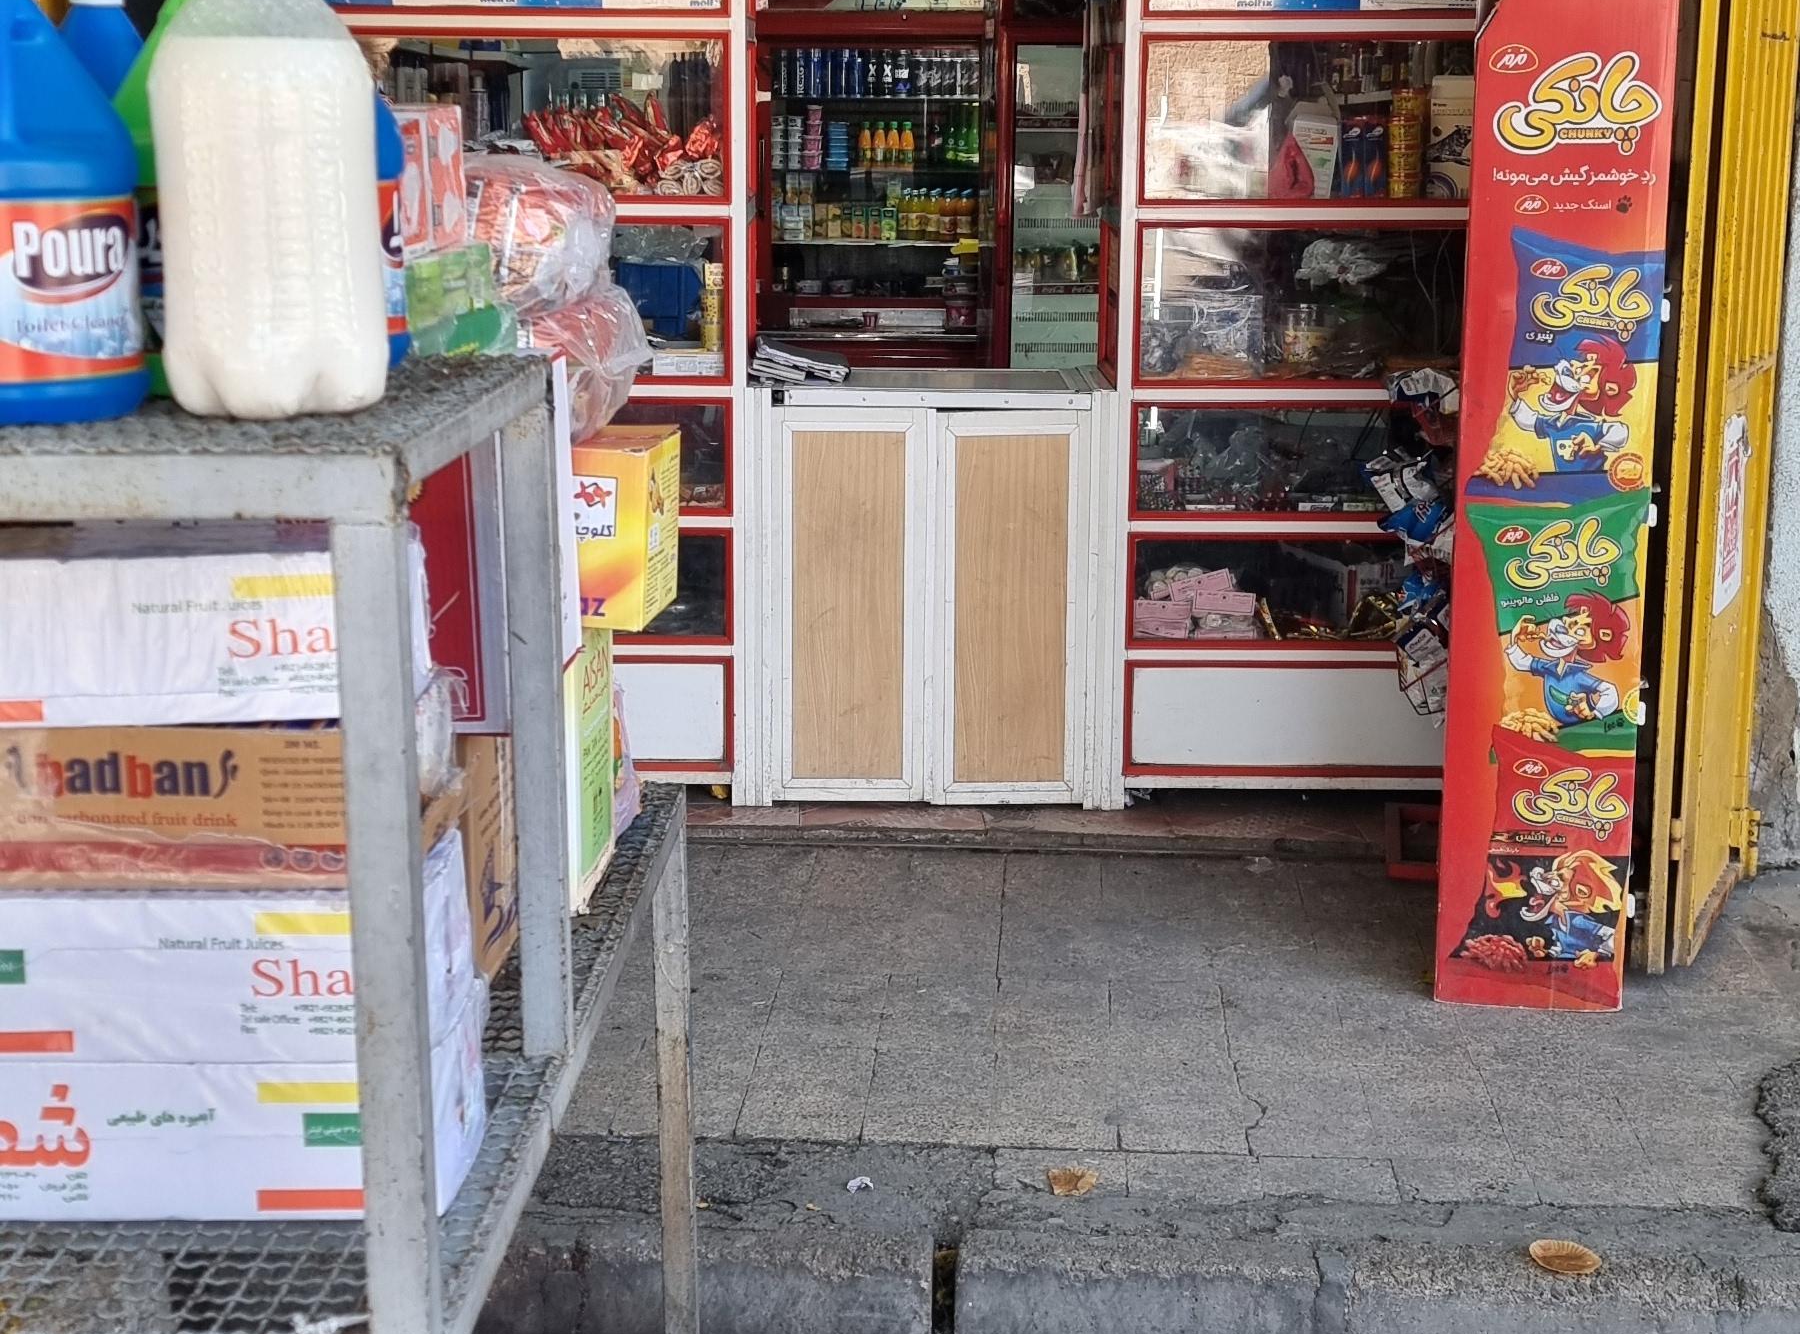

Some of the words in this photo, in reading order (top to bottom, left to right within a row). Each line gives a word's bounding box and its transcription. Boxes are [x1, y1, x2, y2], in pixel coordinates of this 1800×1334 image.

[1496, 48, 1528, 69] مزمز
[1497, 54, 1659, 153] چانکی
[1558, 127, 1614, 140] CHUNKY
[1553, 200, 1579, 211] جدید
[1581, 199, 1611, 210] اسنک
[12, 220, 127, 280] Poura
[1532, 265, 1652, 341] چانکی
[1576, 314, 1616, 328] CHUNKY
[1525, 330, 1554, 344] پنیری
[575, 524, 613, 541] کلوچ
[1506, 518, 1621, 586] چانکی
[1552, 569, 1591, 580] CHUNKY
[132, 601, 182, 615] Natural
[186, 600, 218, 613] Fruit
[580, 597, 606, 617] az
[1535, 593, 1560, 606] فلفلی
[228, 618, 338, 659] Sha
[36, 750, 211, 800] badban
[1513, 768, 1629, 841] چانکی
[152, 811, 187, 827] fruit
[192, 811, 238, 828] drink
[1555, 813, 1594, 827] CHUNKY
[158, 937, 208, 951] Natural
[211, 937, 241, 950] Fruit
[245, 937, 285, 951] Juices
[251, 957, 354, 999] Sha
[107, 1110, 147, 1127] طبیعی
[152, 1111, 176, 1127] های
